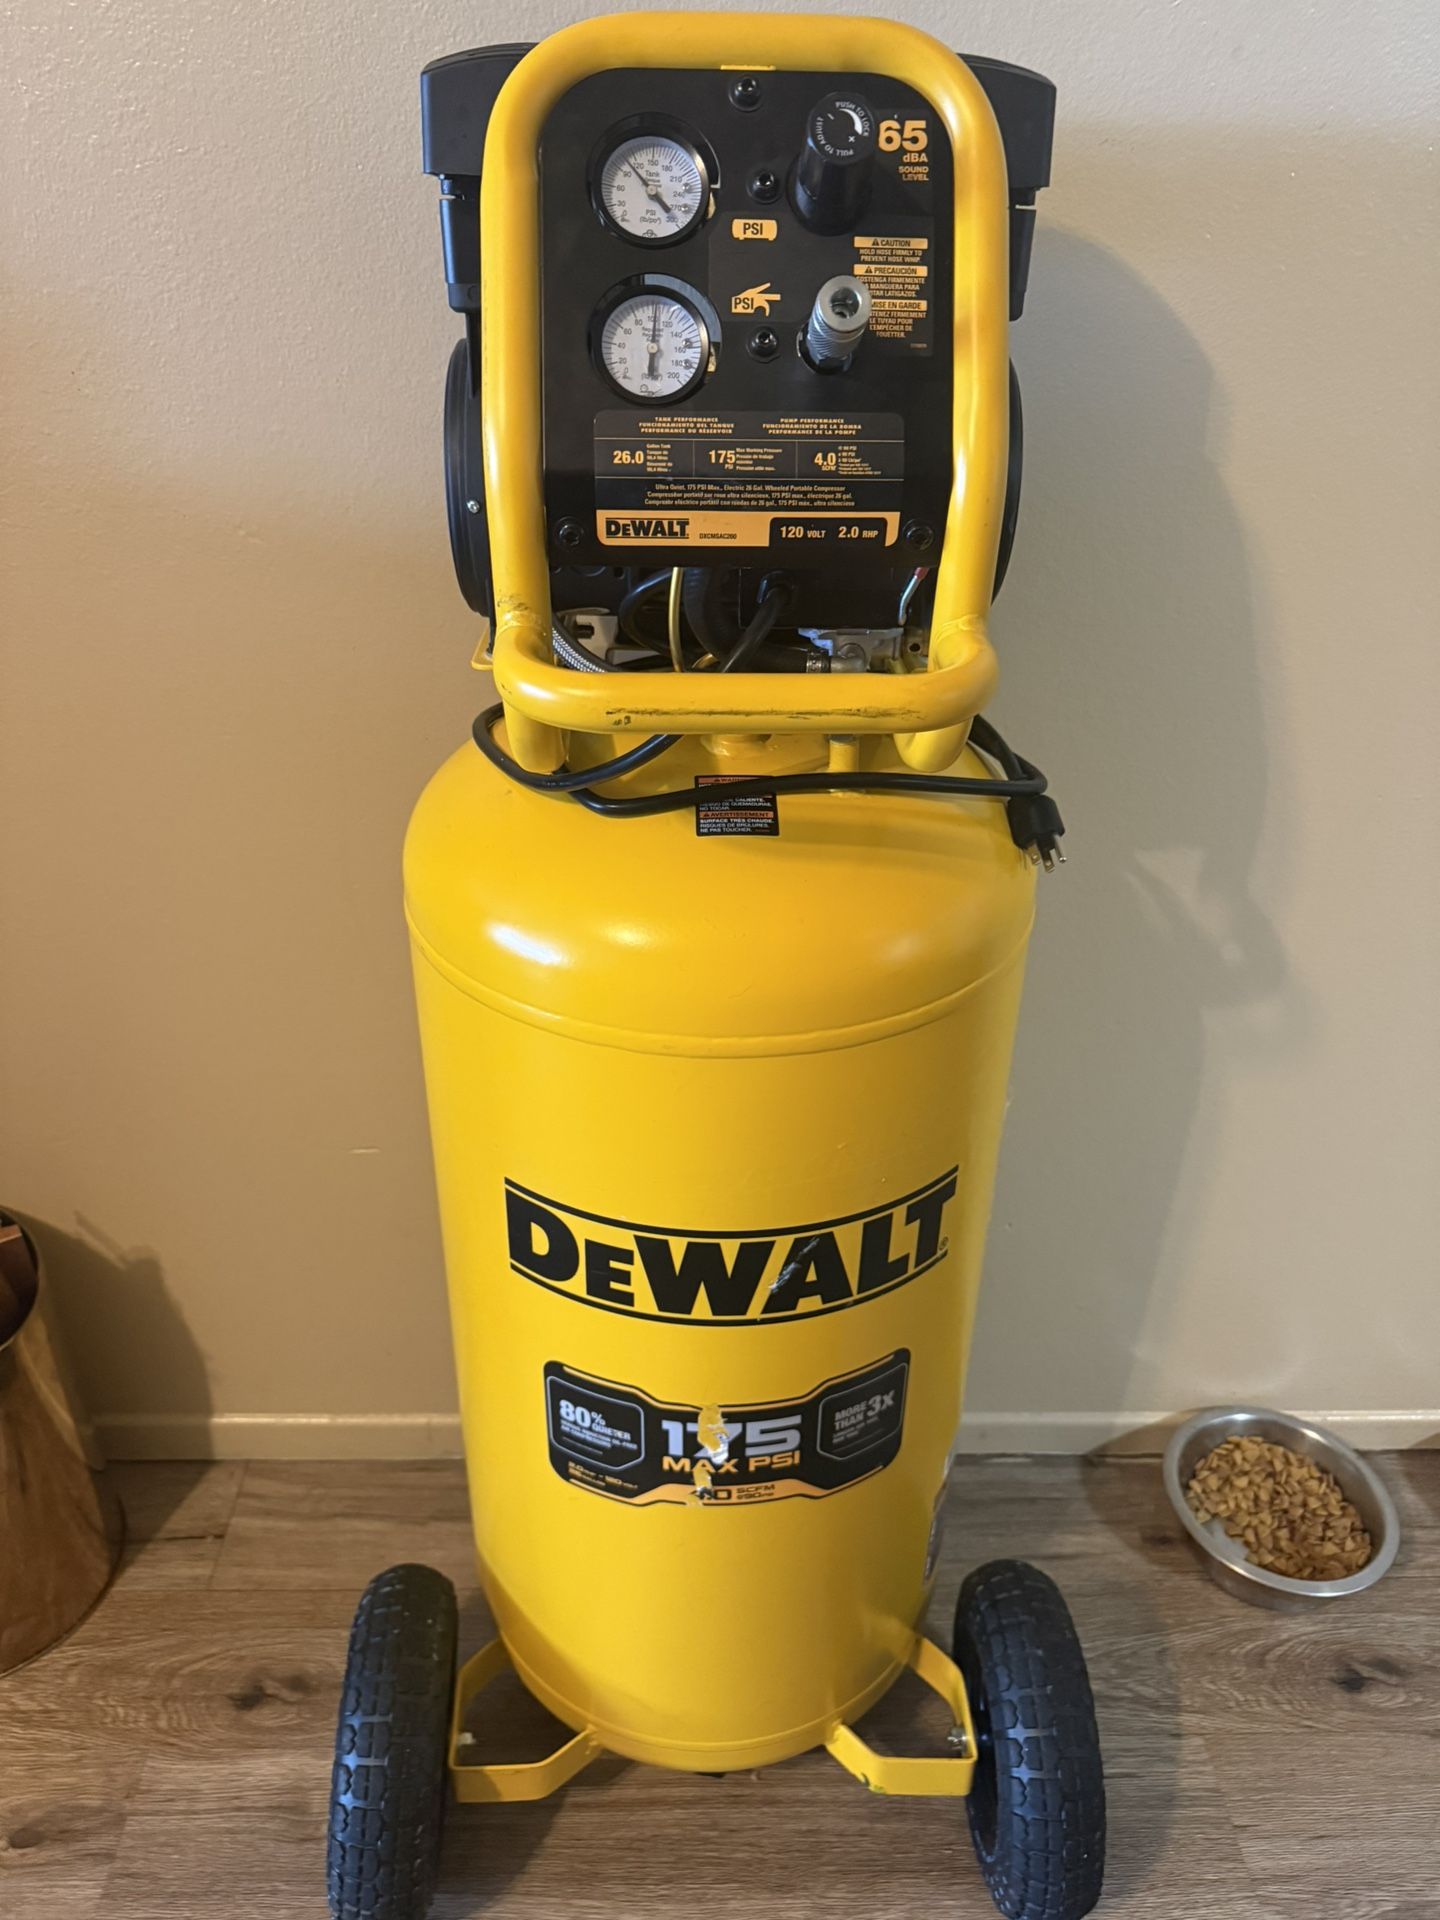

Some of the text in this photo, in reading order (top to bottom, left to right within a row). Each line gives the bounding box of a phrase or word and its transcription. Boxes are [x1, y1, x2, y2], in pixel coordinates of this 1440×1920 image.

[856, 107, 865, 117] TO
[862, 116, 870, 137] LOCK
[816, 117, 854, 157] PULL TO ADJUST
[878, 120, 928, 152] 65
[903, 153, 928, 163] dBA
[743, 223, 763, 235] PSI
[874, 266, 917, 275] PRECAUCIÓN
[734, 298, 754, 310] PSI
[613, 450, 644, 464] 26.0
[709, 450, 736, 464] 175
[814, 453, 836, 466] 4.0
[606, 520, 689, 537] DEWALT
[780, 526, 879, 538] 120 VOLT 2.0 RHP
[505, 1175, 958, 1317] DEWALT
[560, 1400, 606, 1428] 80%
[835, 1400, 867, 1421] MORE
[834, 1412, 864, 1431] THAN
[592, 1424, 631, 1441] QUIETER
[661, 1414, 802, 1457] 175
[662, 1450, 801, 1473] MAX PSI
[736, 1484, 776, 1494] SCFM
